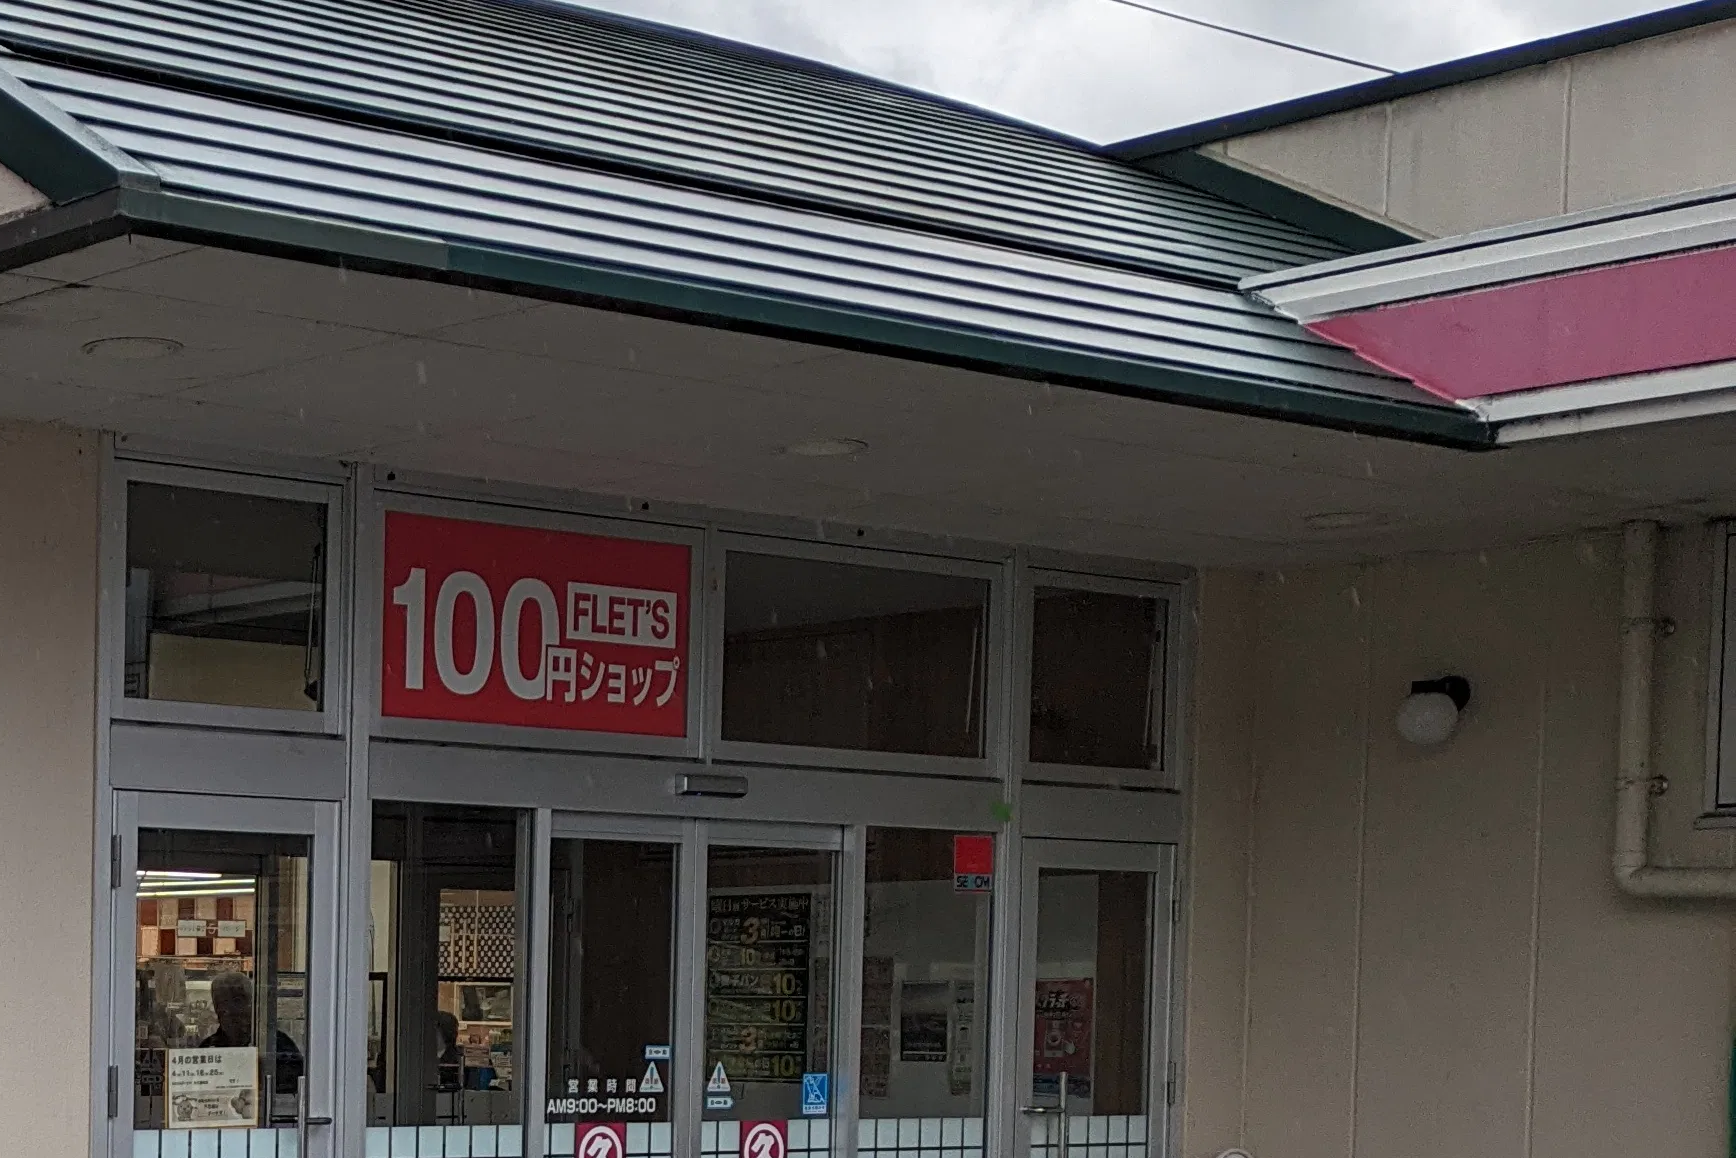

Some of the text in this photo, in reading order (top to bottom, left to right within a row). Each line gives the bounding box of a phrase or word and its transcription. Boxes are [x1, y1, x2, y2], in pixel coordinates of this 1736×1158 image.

[392, 567, 680, 708] 100 円ショップ
[573, 592, 671, 640] FLET'S
